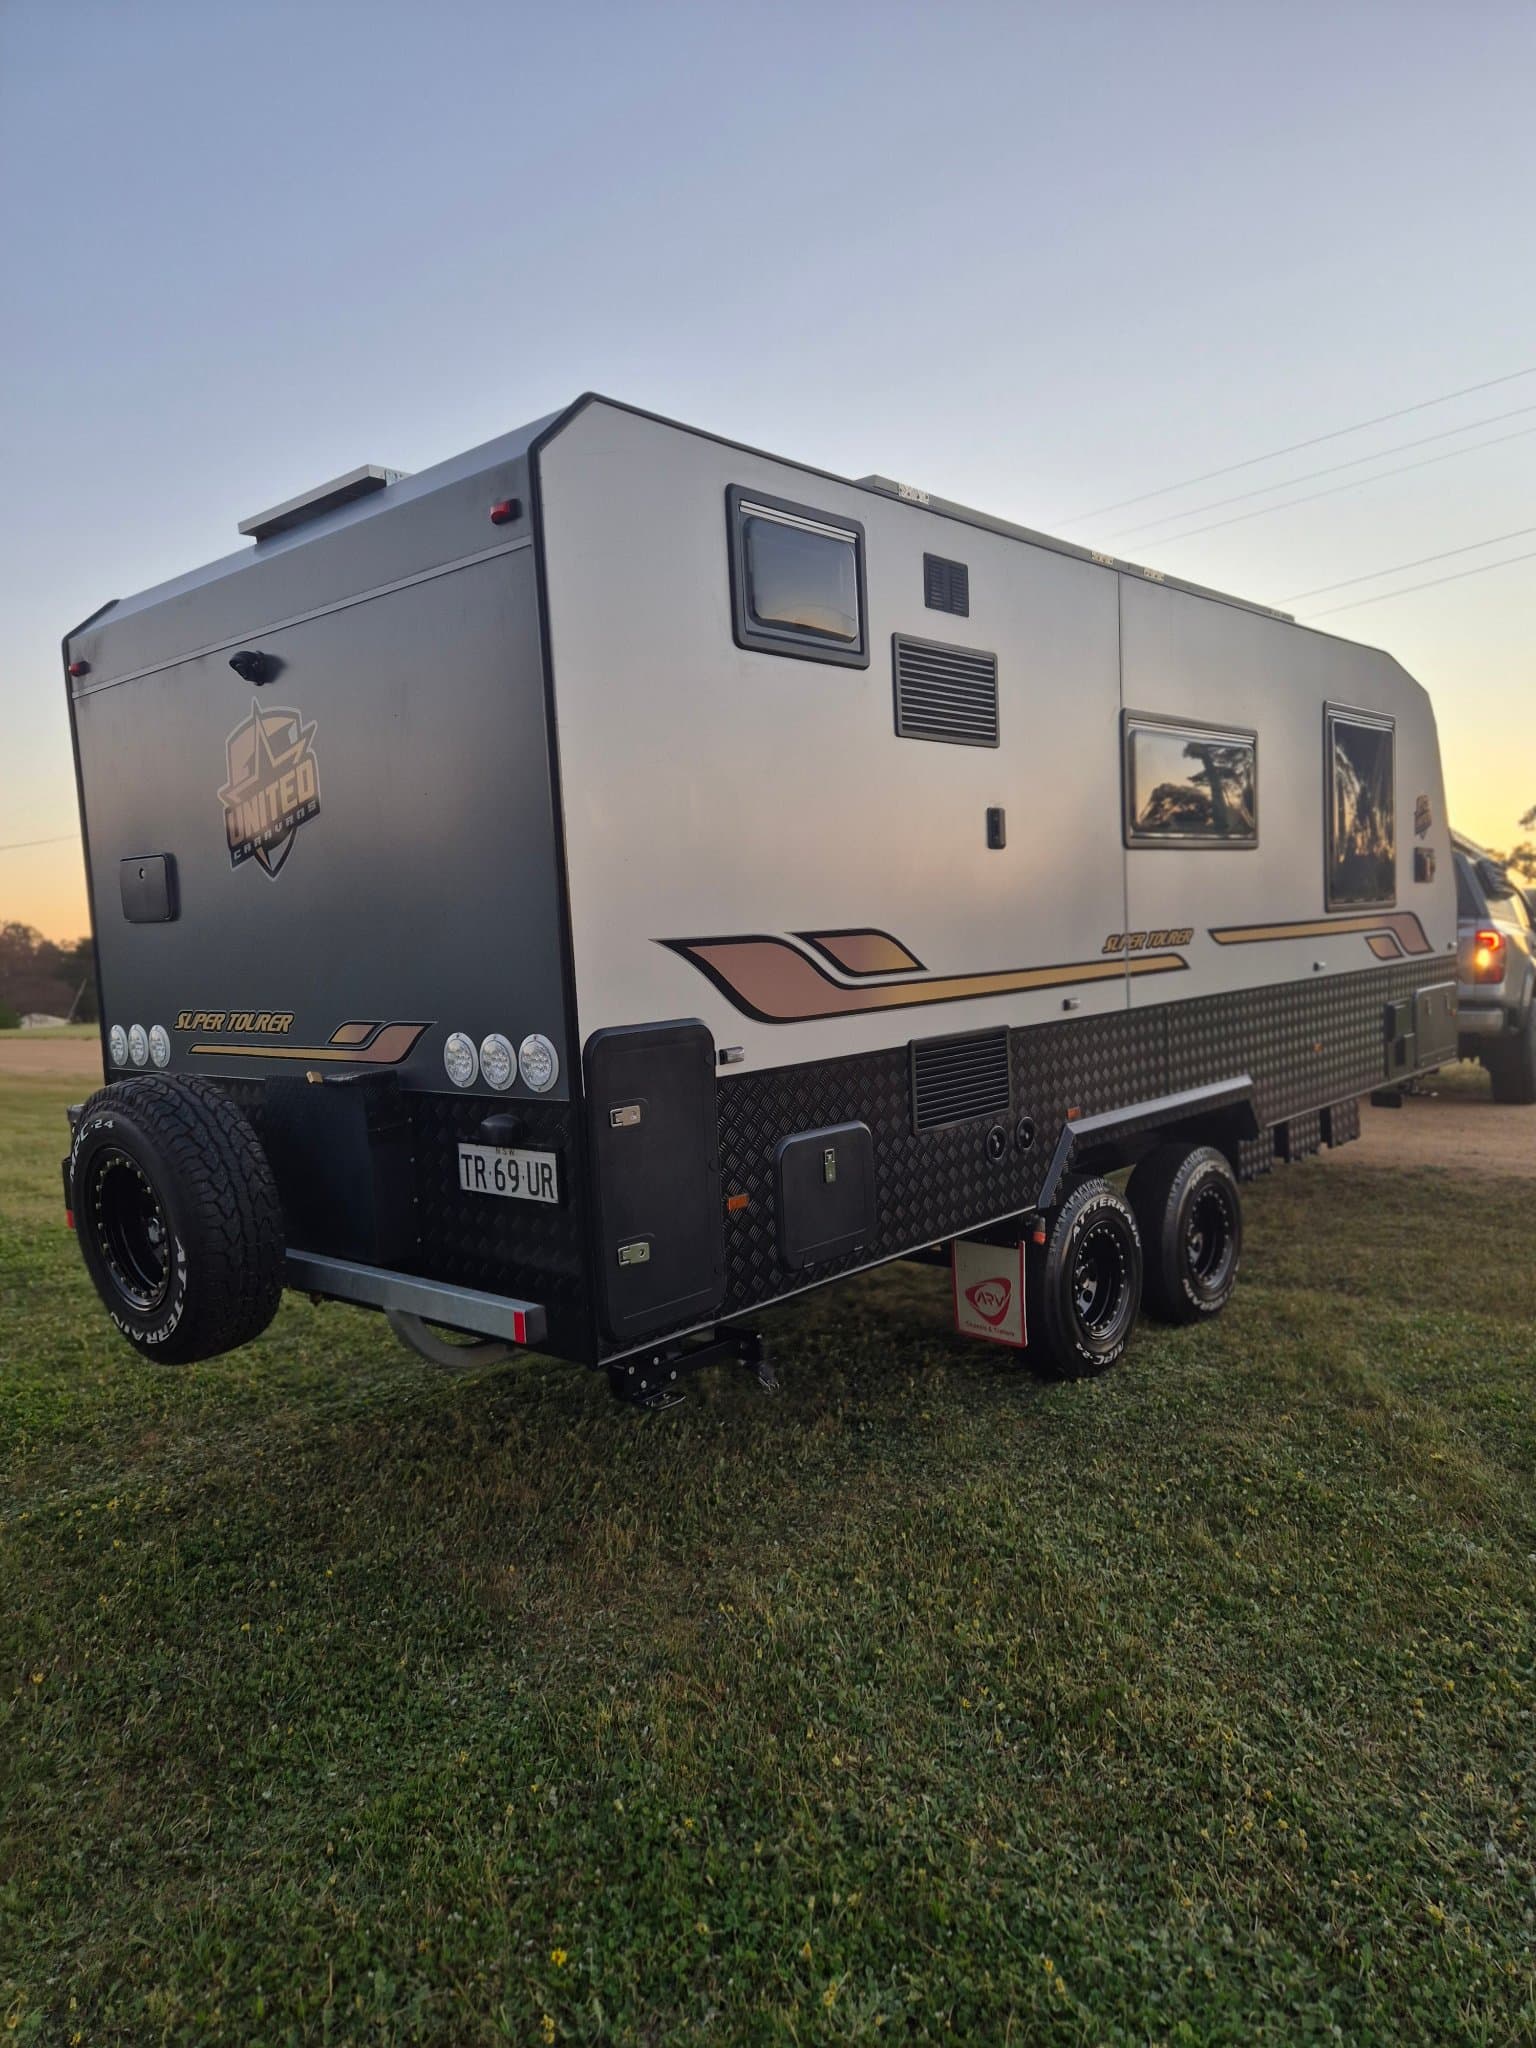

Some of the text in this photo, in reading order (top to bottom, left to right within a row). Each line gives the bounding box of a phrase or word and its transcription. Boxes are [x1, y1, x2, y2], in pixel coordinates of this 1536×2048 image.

[226, 759, 315, 847] UNITED
[233, 800, 317, 860] CARAVANS
[174, 1011, 295, 1033] SUPER TOURER
[977, 1291, 1006, 1308] ARV
